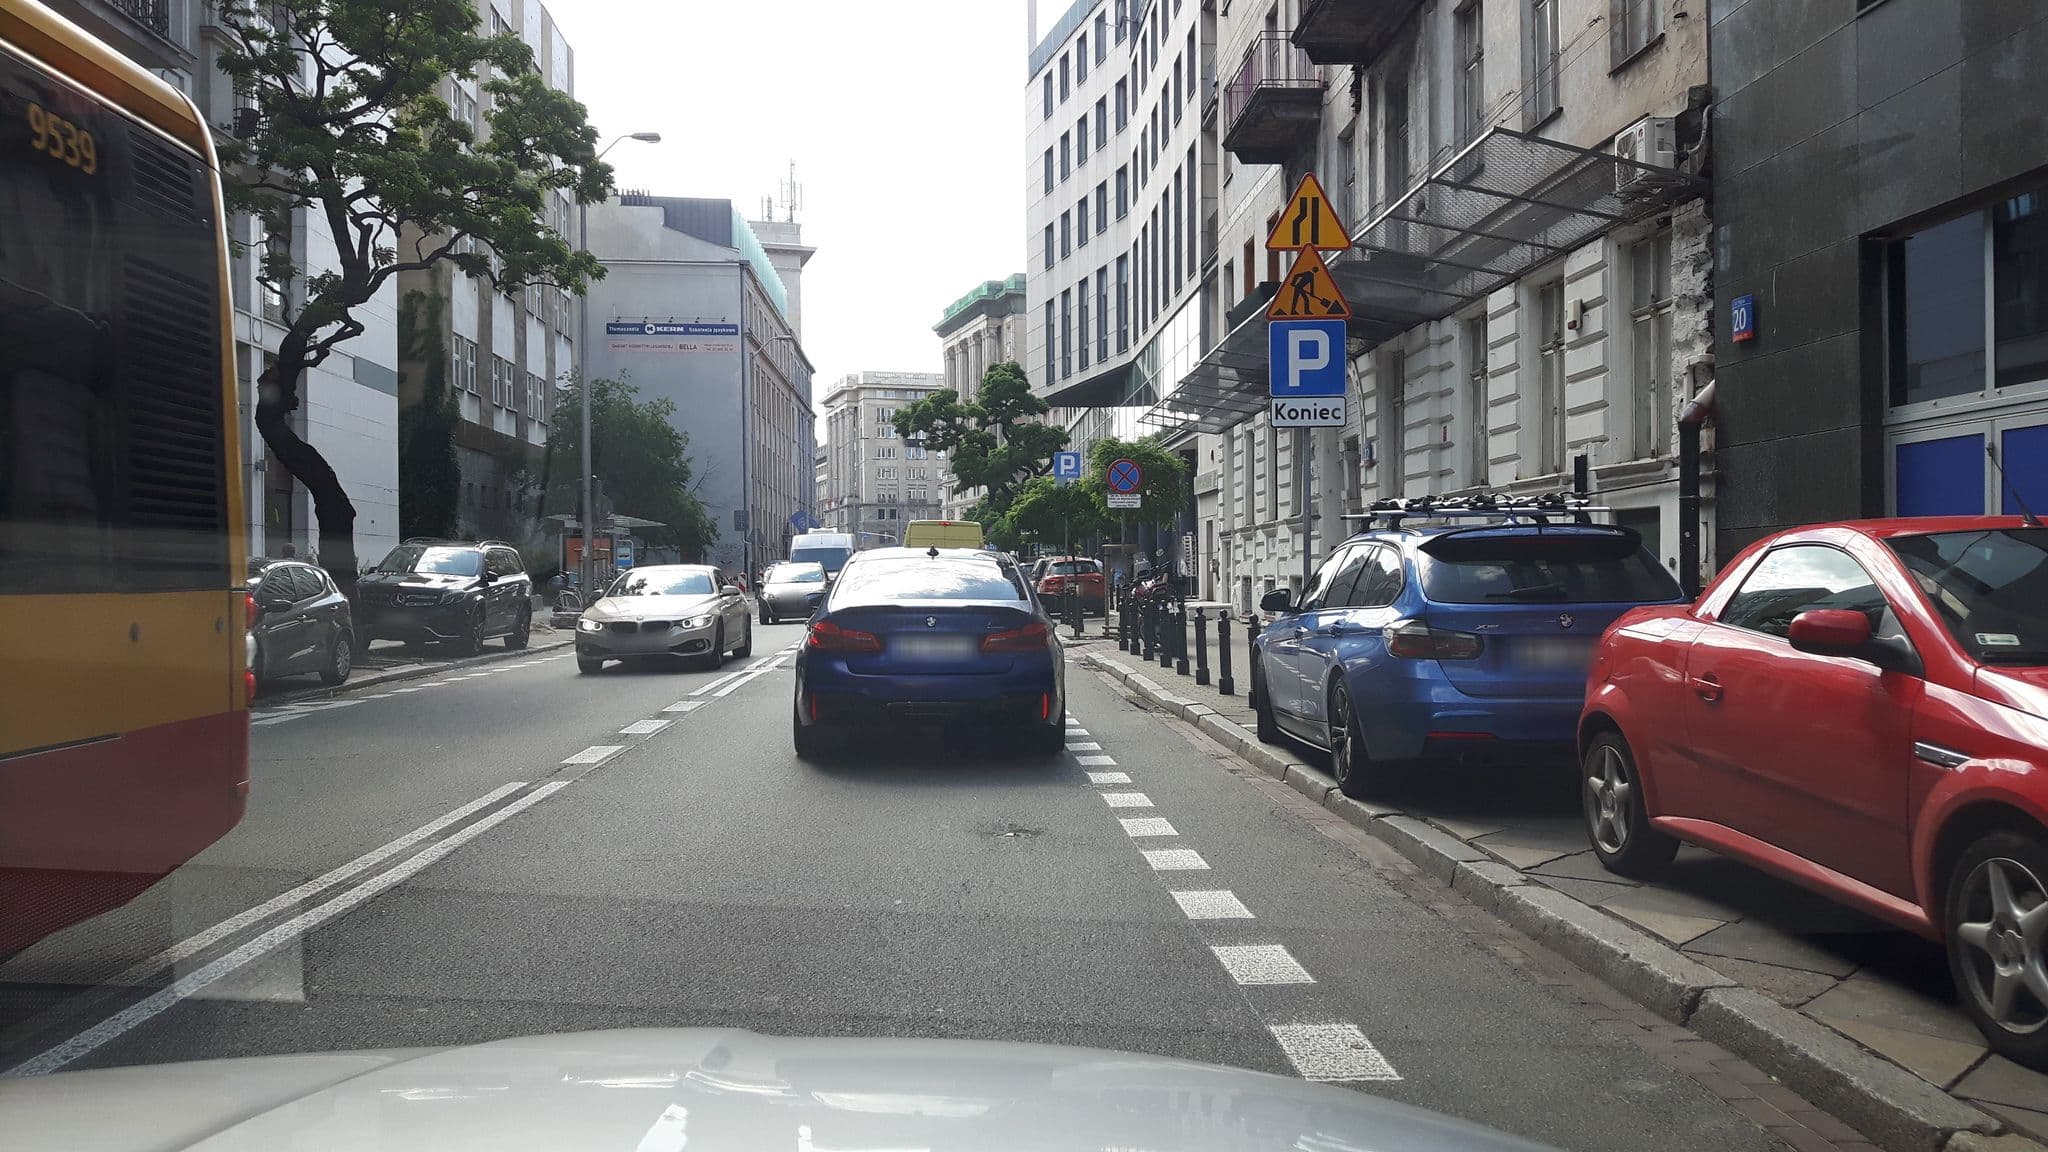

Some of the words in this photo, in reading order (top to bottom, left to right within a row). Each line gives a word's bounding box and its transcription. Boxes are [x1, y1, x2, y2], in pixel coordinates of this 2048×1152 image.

[26, 102, 97, 176] 9539
[1733, 307, 1747, 332] 20
[1288, 329, 1330, 387] P
[1275, 402, 1341, 420] Koniec
[1060, 455, 1075, 475] P
